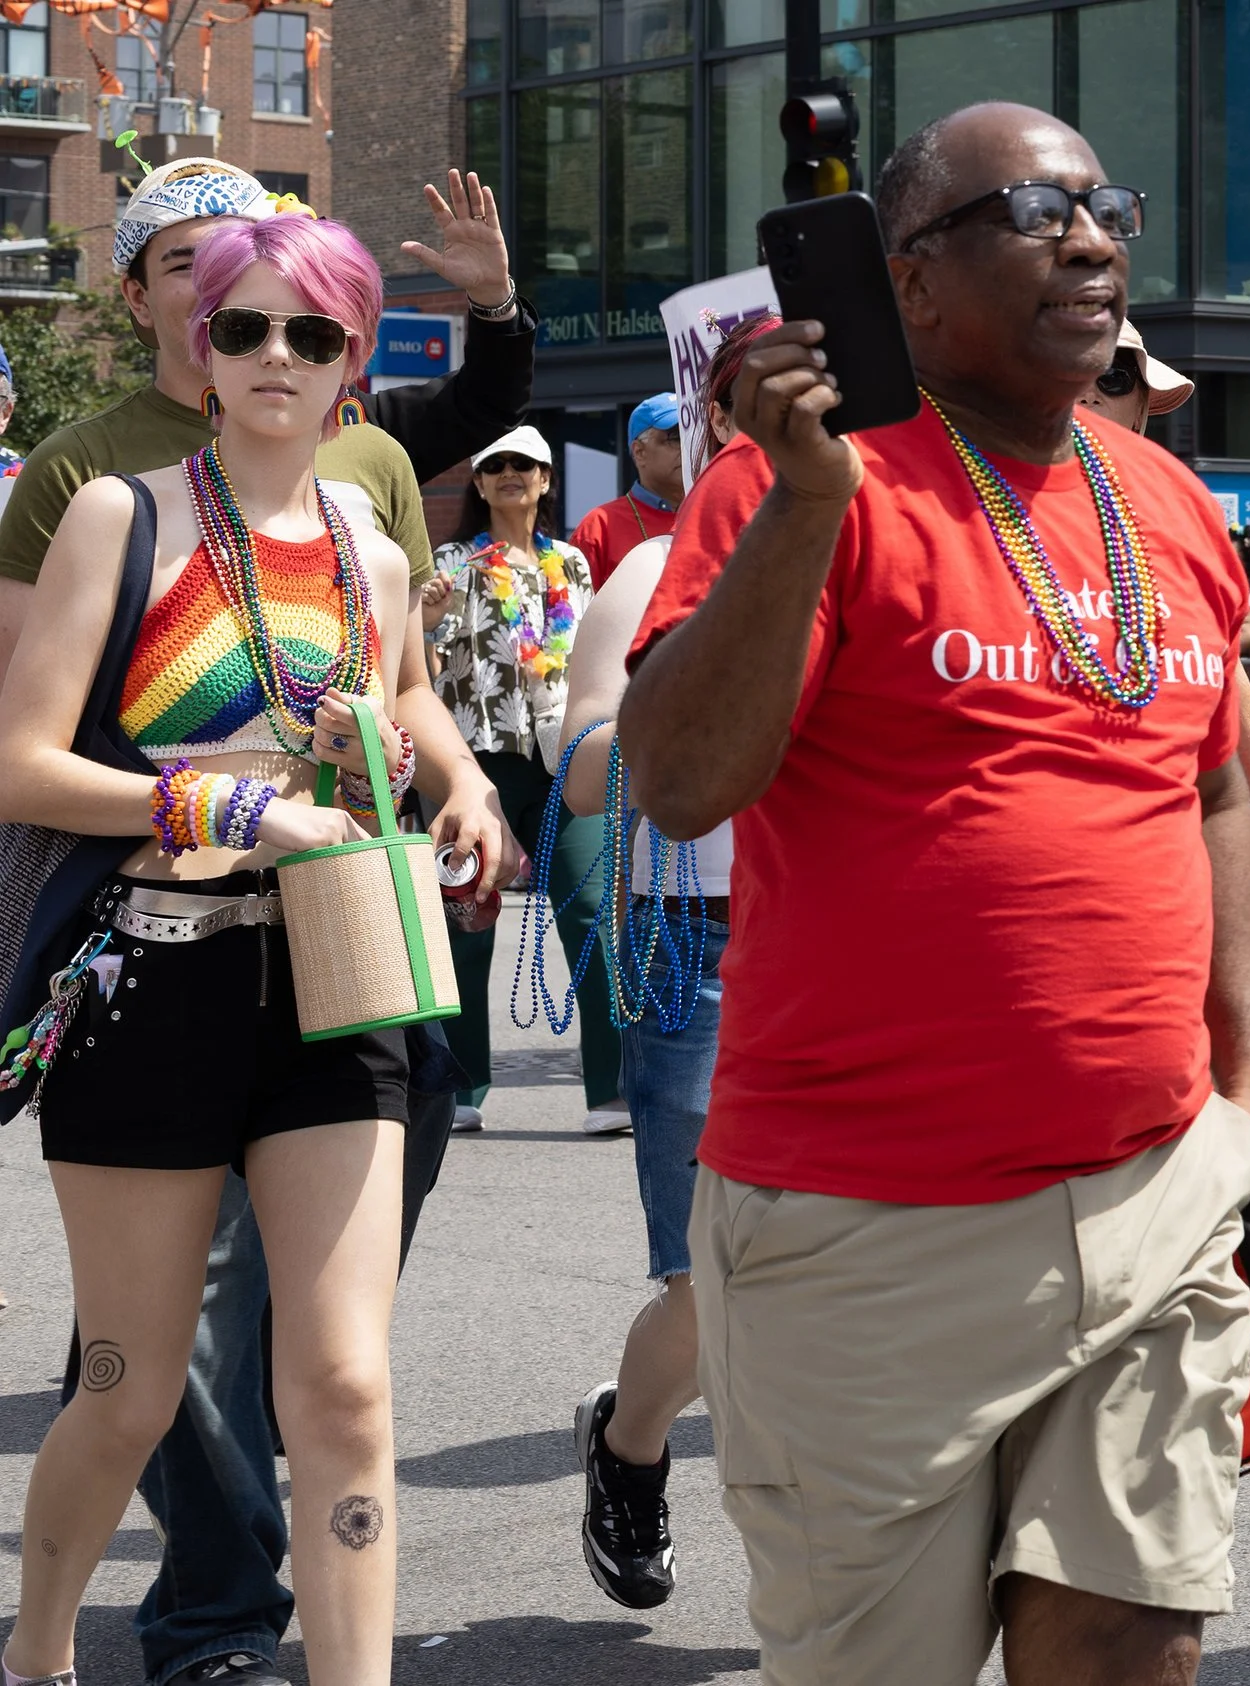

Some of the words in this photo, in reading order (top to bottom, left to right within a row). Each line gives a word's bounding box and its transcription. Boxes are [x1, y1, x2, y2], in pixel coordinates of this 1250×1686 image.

[544, 316, 579, 342] 3601
[388, 340, 422, 354] BMO
[1025, 578, 1114, 620] ate
[932, 629, 1040, 683] Out
[1116, 635, 1226, 688] Orde
